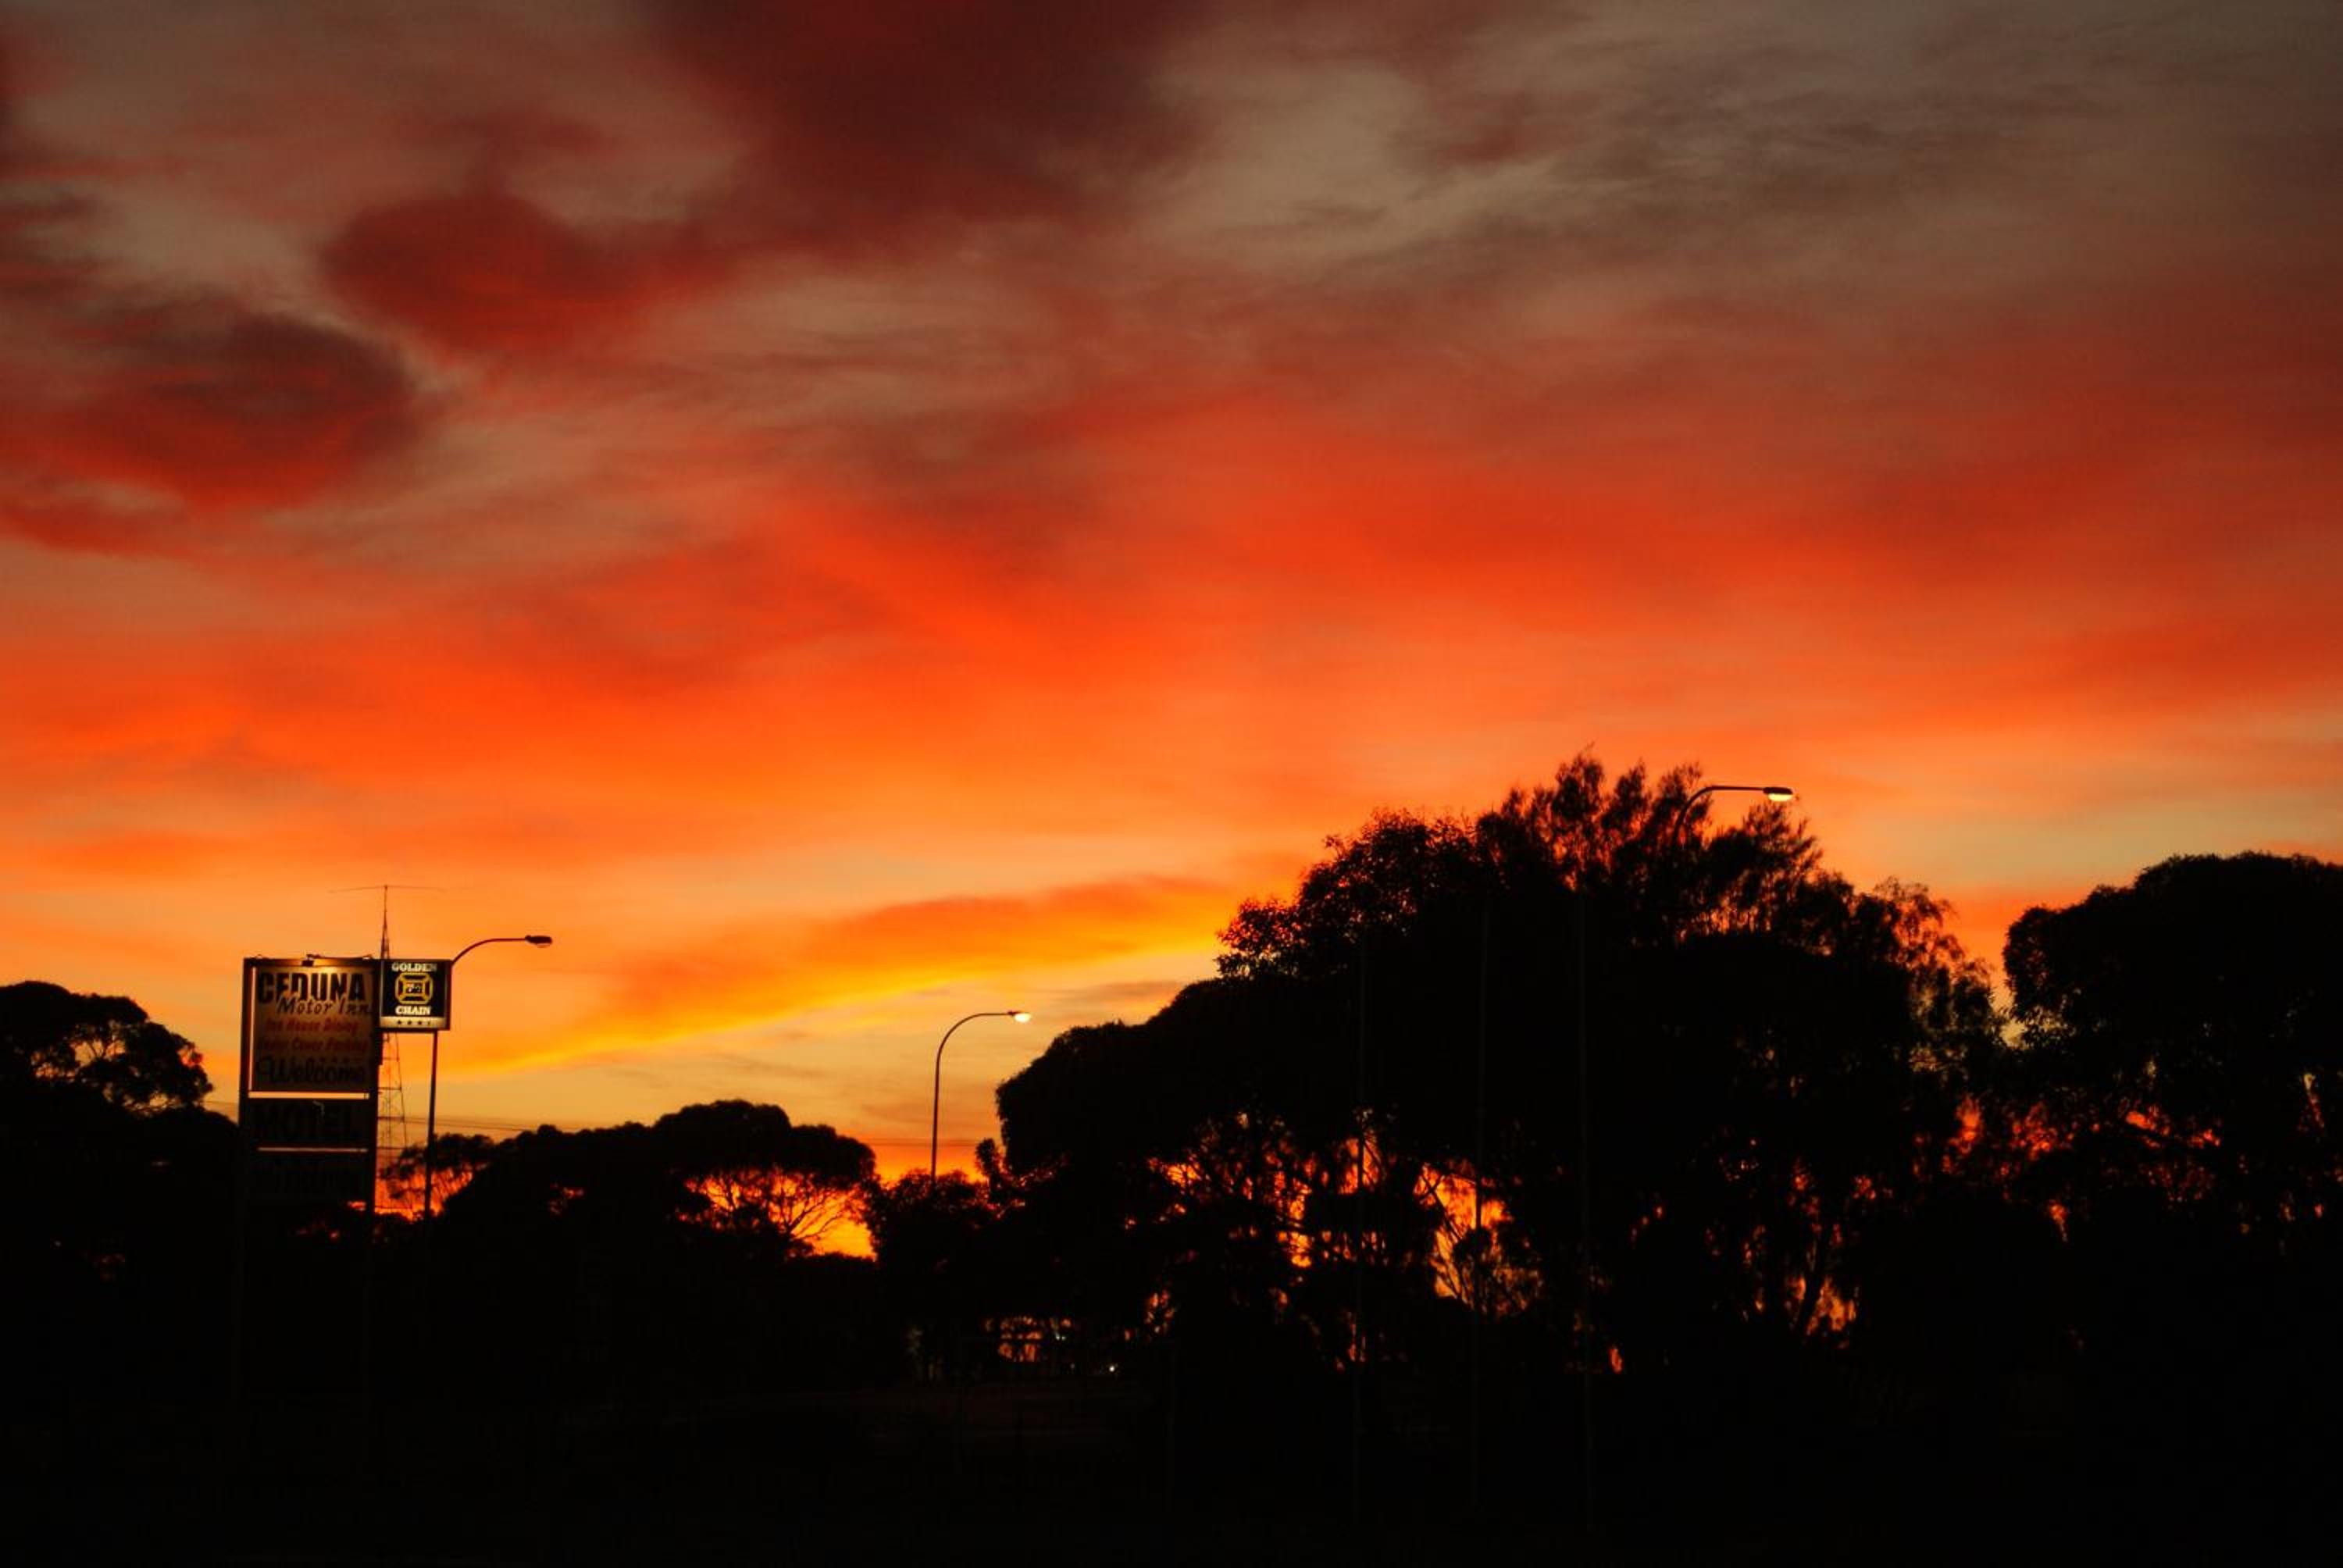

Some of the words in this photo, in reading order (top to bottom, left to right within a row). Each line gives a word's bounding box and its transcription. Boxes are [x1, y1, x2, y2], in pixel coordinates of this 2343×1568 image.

[391, 962, 437, 972] GOLDEN
[257, 972, 366, 1003] CEDUNA
[277, 998, 333, 1014] Motor
[339, 999, 370, 1014] Inn
[395, 1006, 431, 1015] CHAIN
[256, 1057, 366, 1084] Welcome
